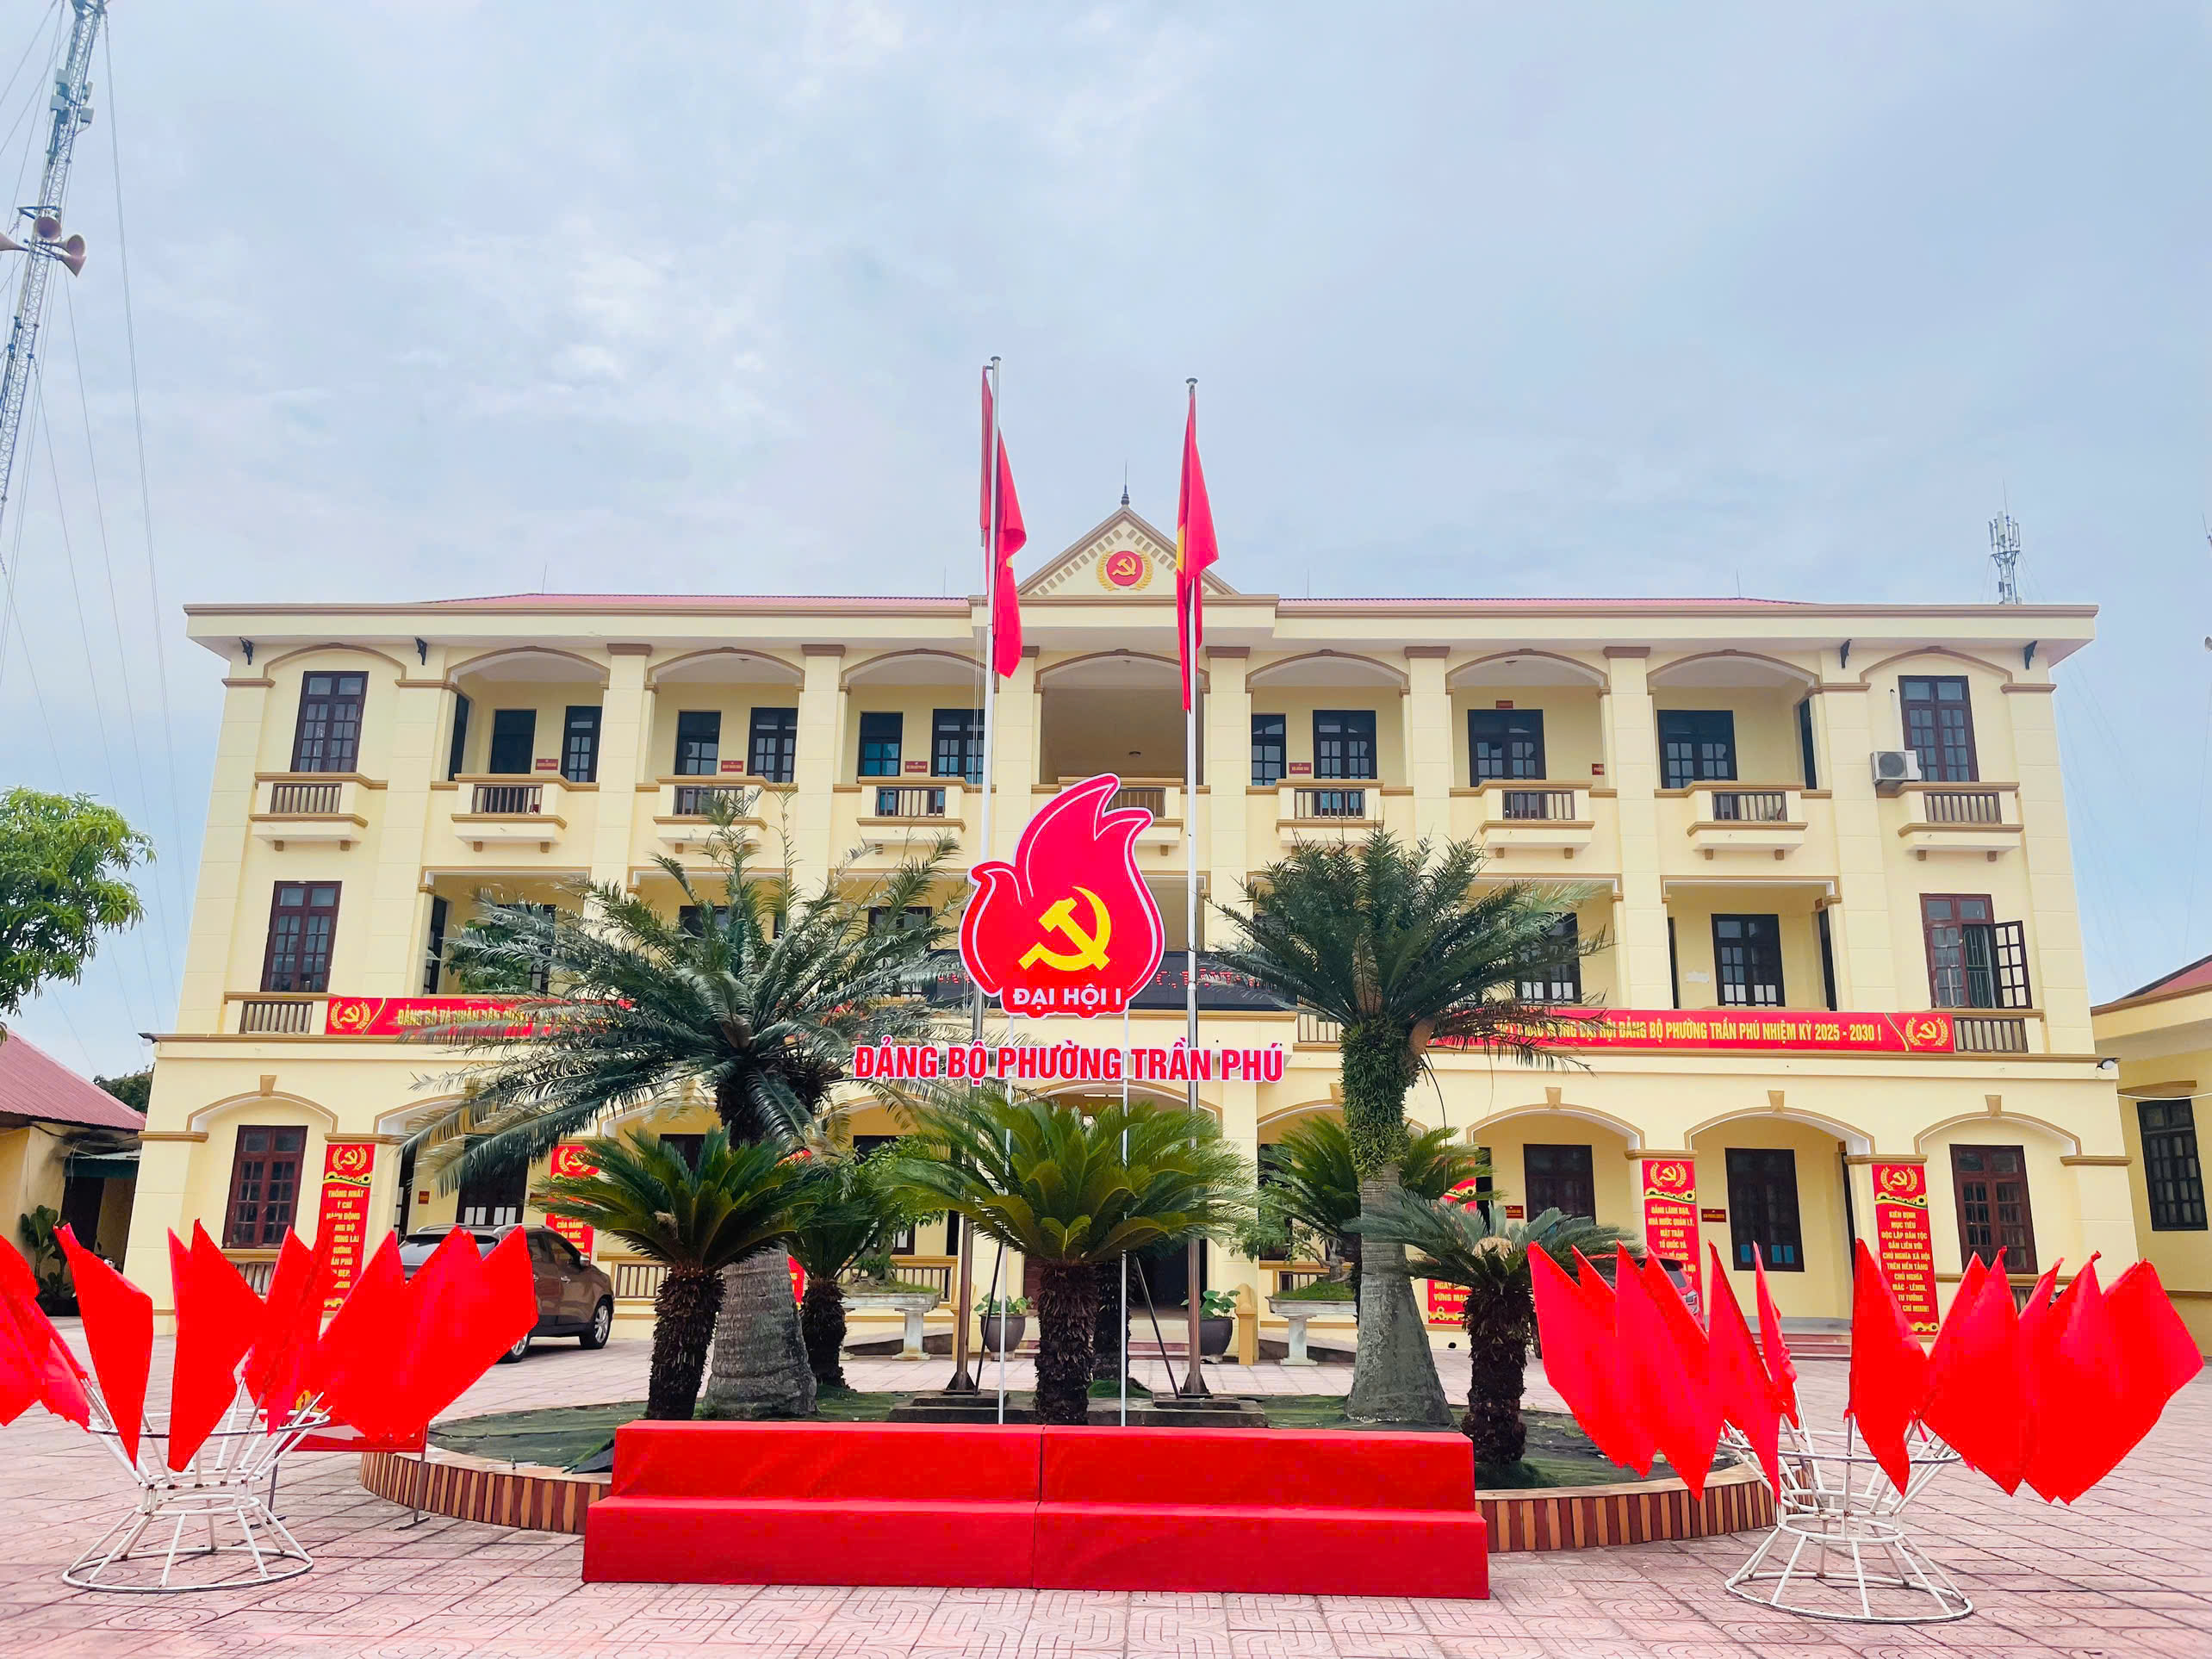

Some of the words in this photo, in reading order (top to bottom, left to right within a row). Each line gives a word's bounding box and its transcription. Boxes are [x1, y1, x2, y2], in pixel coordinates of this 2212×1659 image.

[1013, 989, 1054, 1010] ĐẠI
[1063, 984, 1107, 1010] HỘI
[1115, 989, 1121, 1004] I
[1619, 1016, 1646, 1039] ĐẢNG
[1649, 1018, 1663, 1043] BỘ
[1665, 1018, 1708, 1040] PHƯỜNG
[1709, 1016, 1737, 1041] TRẦN
[1739, 1019, 1761, 1041] PHÚ
[1762, 1020, 1798, 1044] NHIỆM
[1799, 1020, 1812, 1041] KỲ
[1815, 1023, 1840, 1041] 2025
[1849, 1024, 1874, 1041] 2030
[854, 1035, 939, 1079] ĐẢNG
[948, 1040, 987, 1086] BỘ
[997, 1040, 1122, 1080] PHƯỜNG
[1130, 1037, 1211, 1082] TRẦN
[1221, 1042, 1284, 1083] PHÚ
